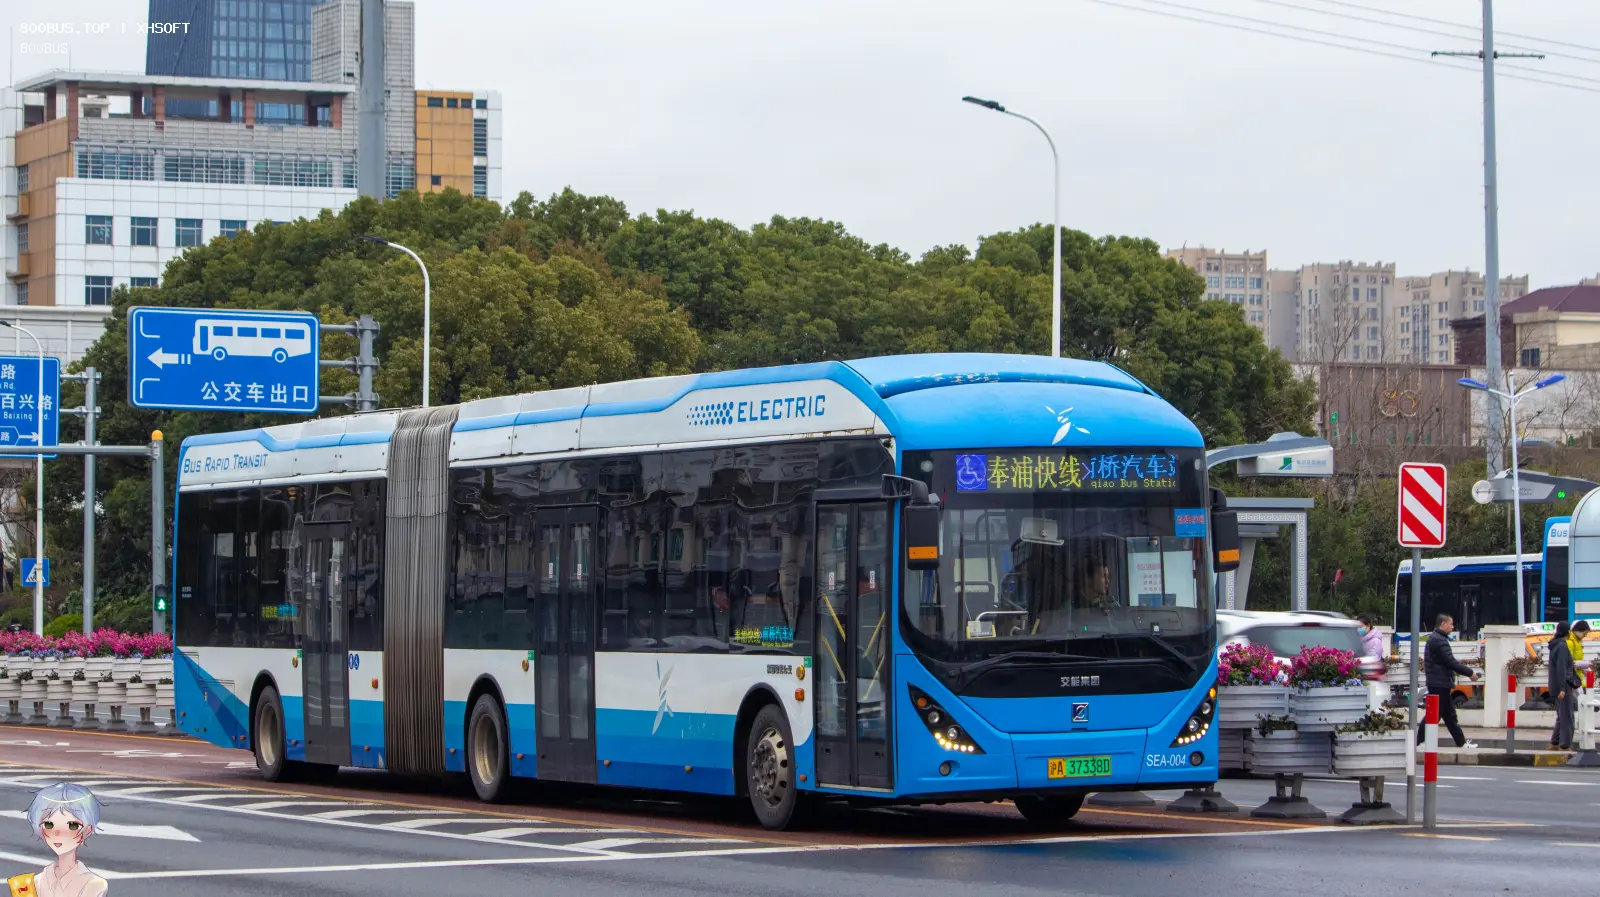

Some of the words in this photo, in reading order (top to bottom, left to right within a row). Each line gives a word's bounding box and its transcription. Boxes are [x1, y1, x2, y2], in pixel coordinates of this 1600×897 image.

[0, 364, 16, 380] 路
[200, 380, 309, 404] 公交车出口
[0, 394, 53, 411] 百兴路
[737, 395, 826, 423] ELECTRIC
[3, 412, 33, 422] Baixing
[987, 455, 1082, 489] 奉浦快线
[1120, 478, 1138, 488] Bus
[1068, 758, 1110, 776] 37338D
[1146, 754, 1186, 767] SEA-004
